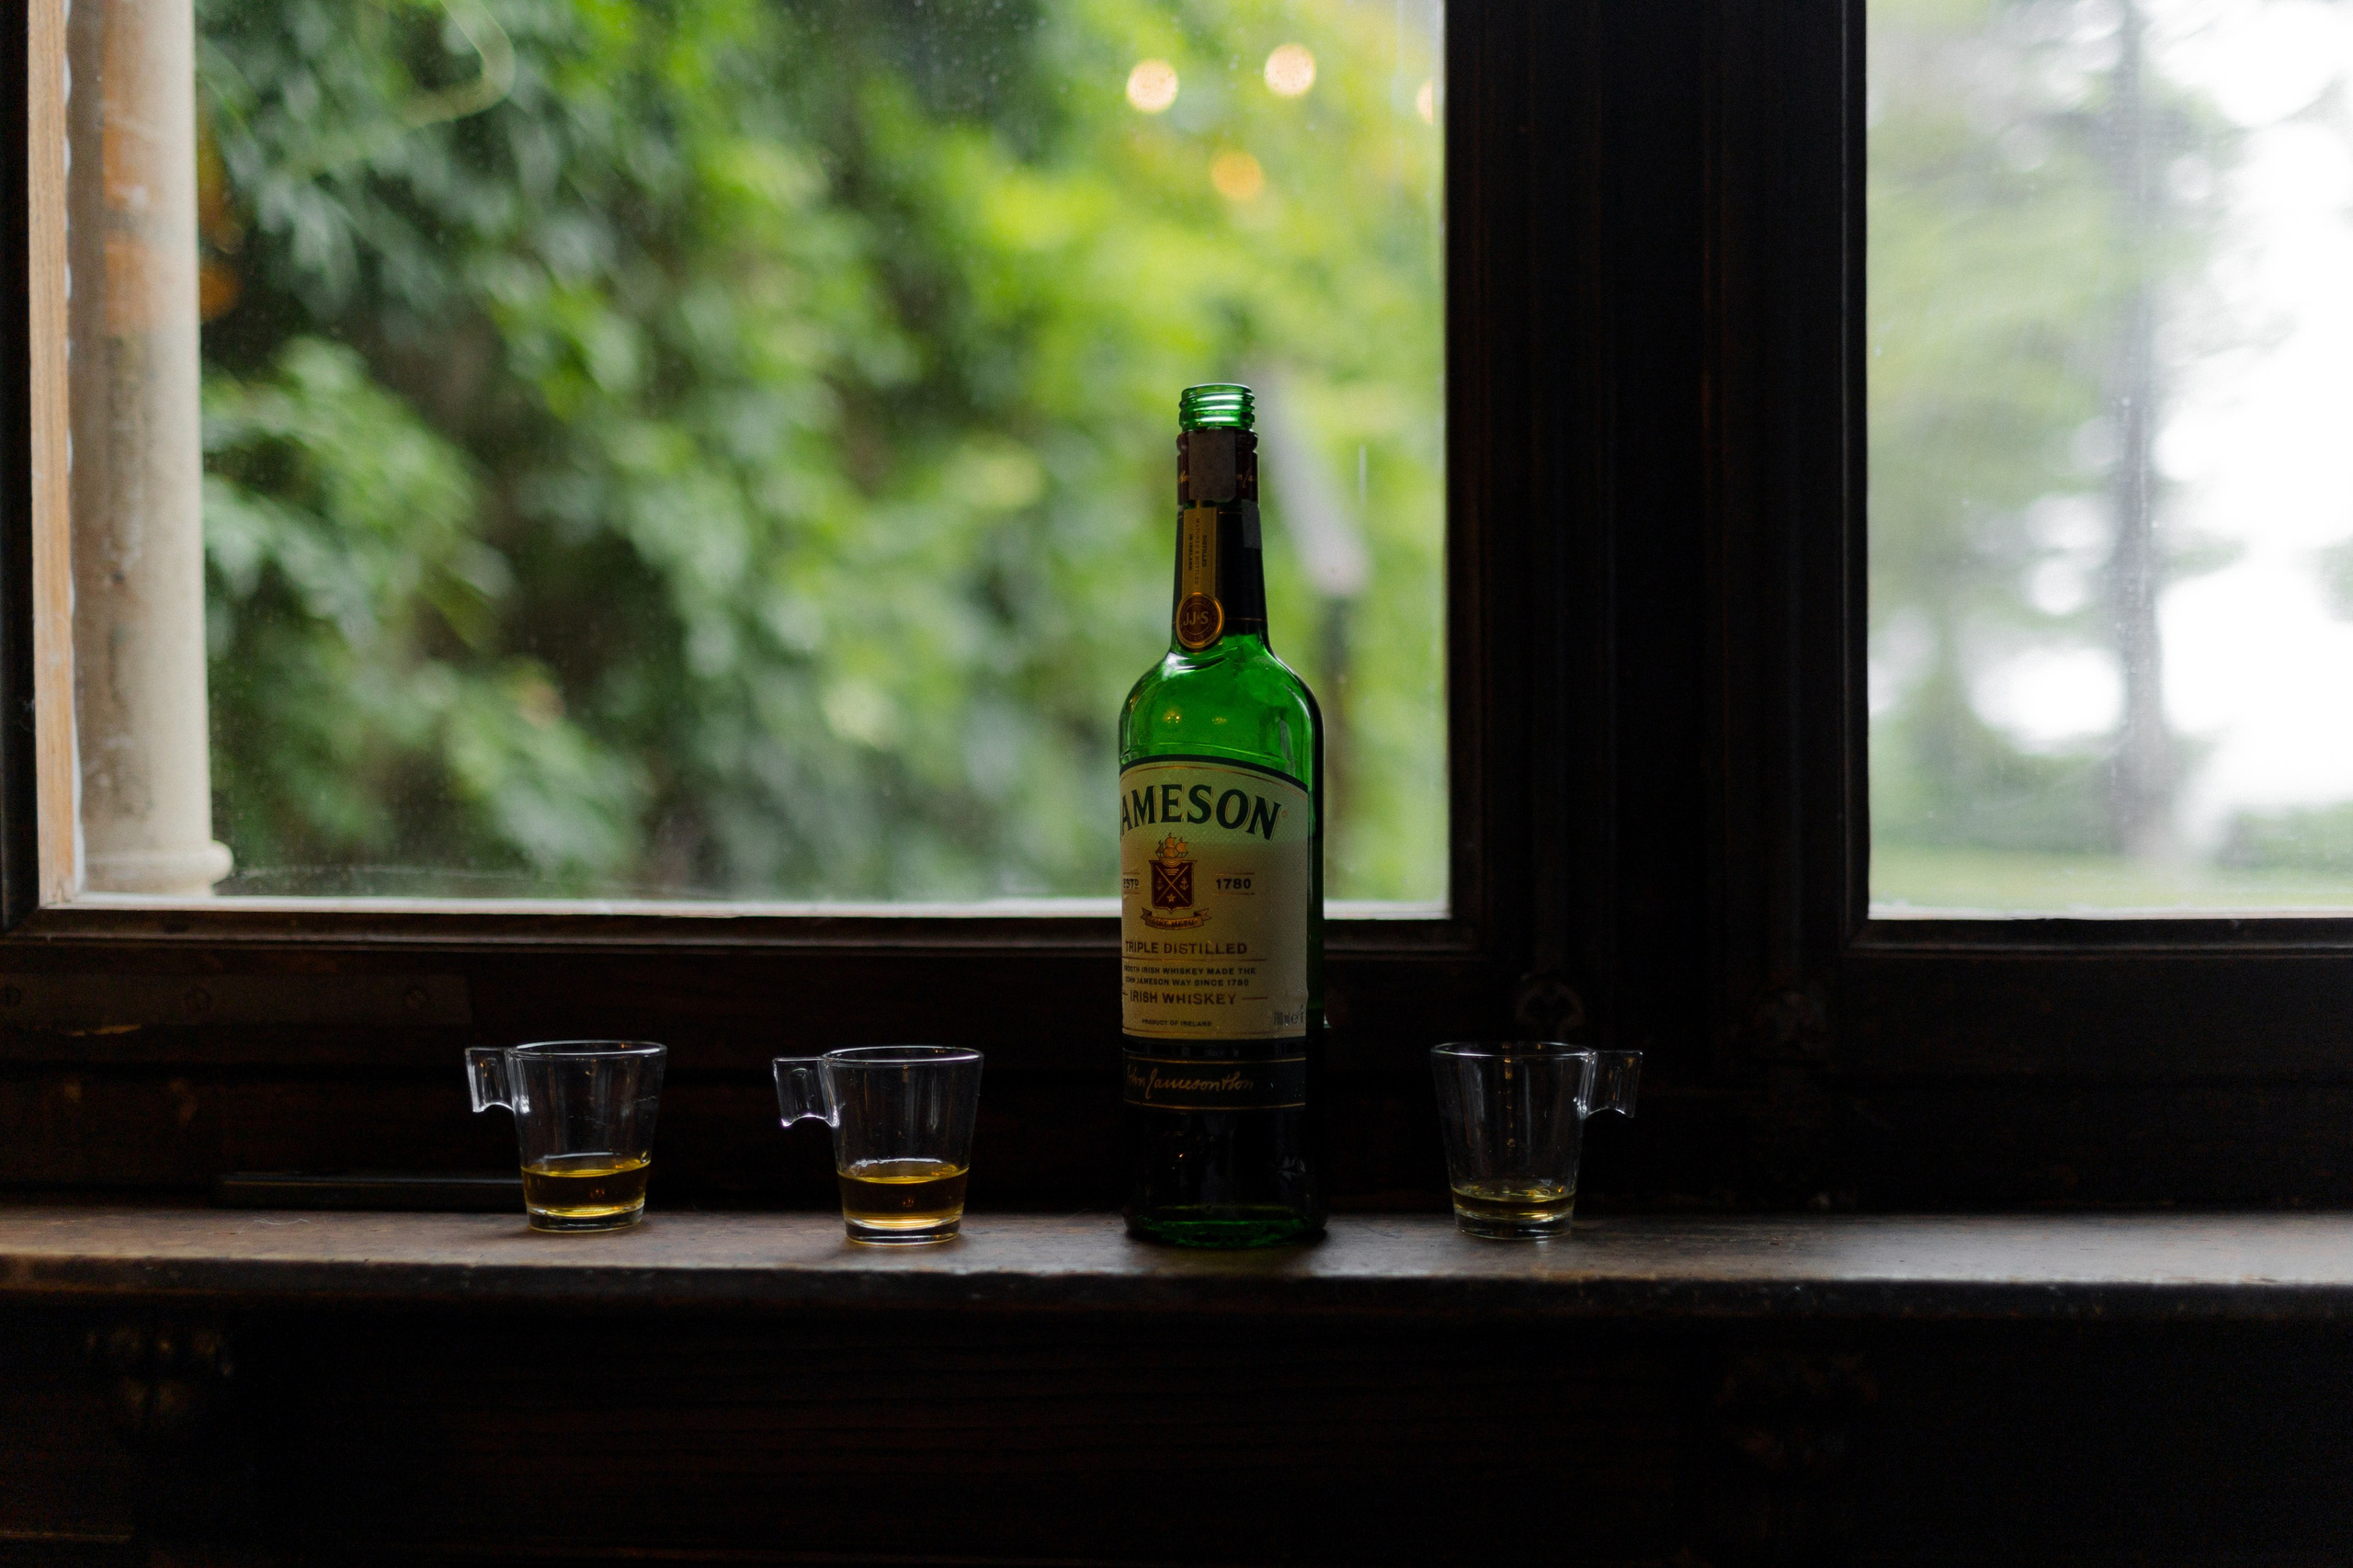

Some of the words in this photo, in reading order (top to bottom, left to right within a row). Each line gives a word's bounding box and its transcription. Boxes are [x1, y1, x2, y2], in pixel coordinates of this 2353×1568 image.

[1121, 784, 1282, 841] AMESON
[1215, 878, 1252, 890] 1780
[1125, 940, 1159, 954] TRIPLE
[1164, 942, 1247, 955] DISTILLED
[1142, 966, 1160, 974] IRISH
[1163, 967, 1204, 975] WHISKEY
[1207, 967, 1234, 975] MADE
[1238, 967, 1256, 975] THE
[1136, 977, 1169, 986] JAMESON
[1194, 979, 1224, 987] SINCE
[1130, 990, 1158, 1003] IRISH
[1162, 992, 1236, 1005] WHISKEY
